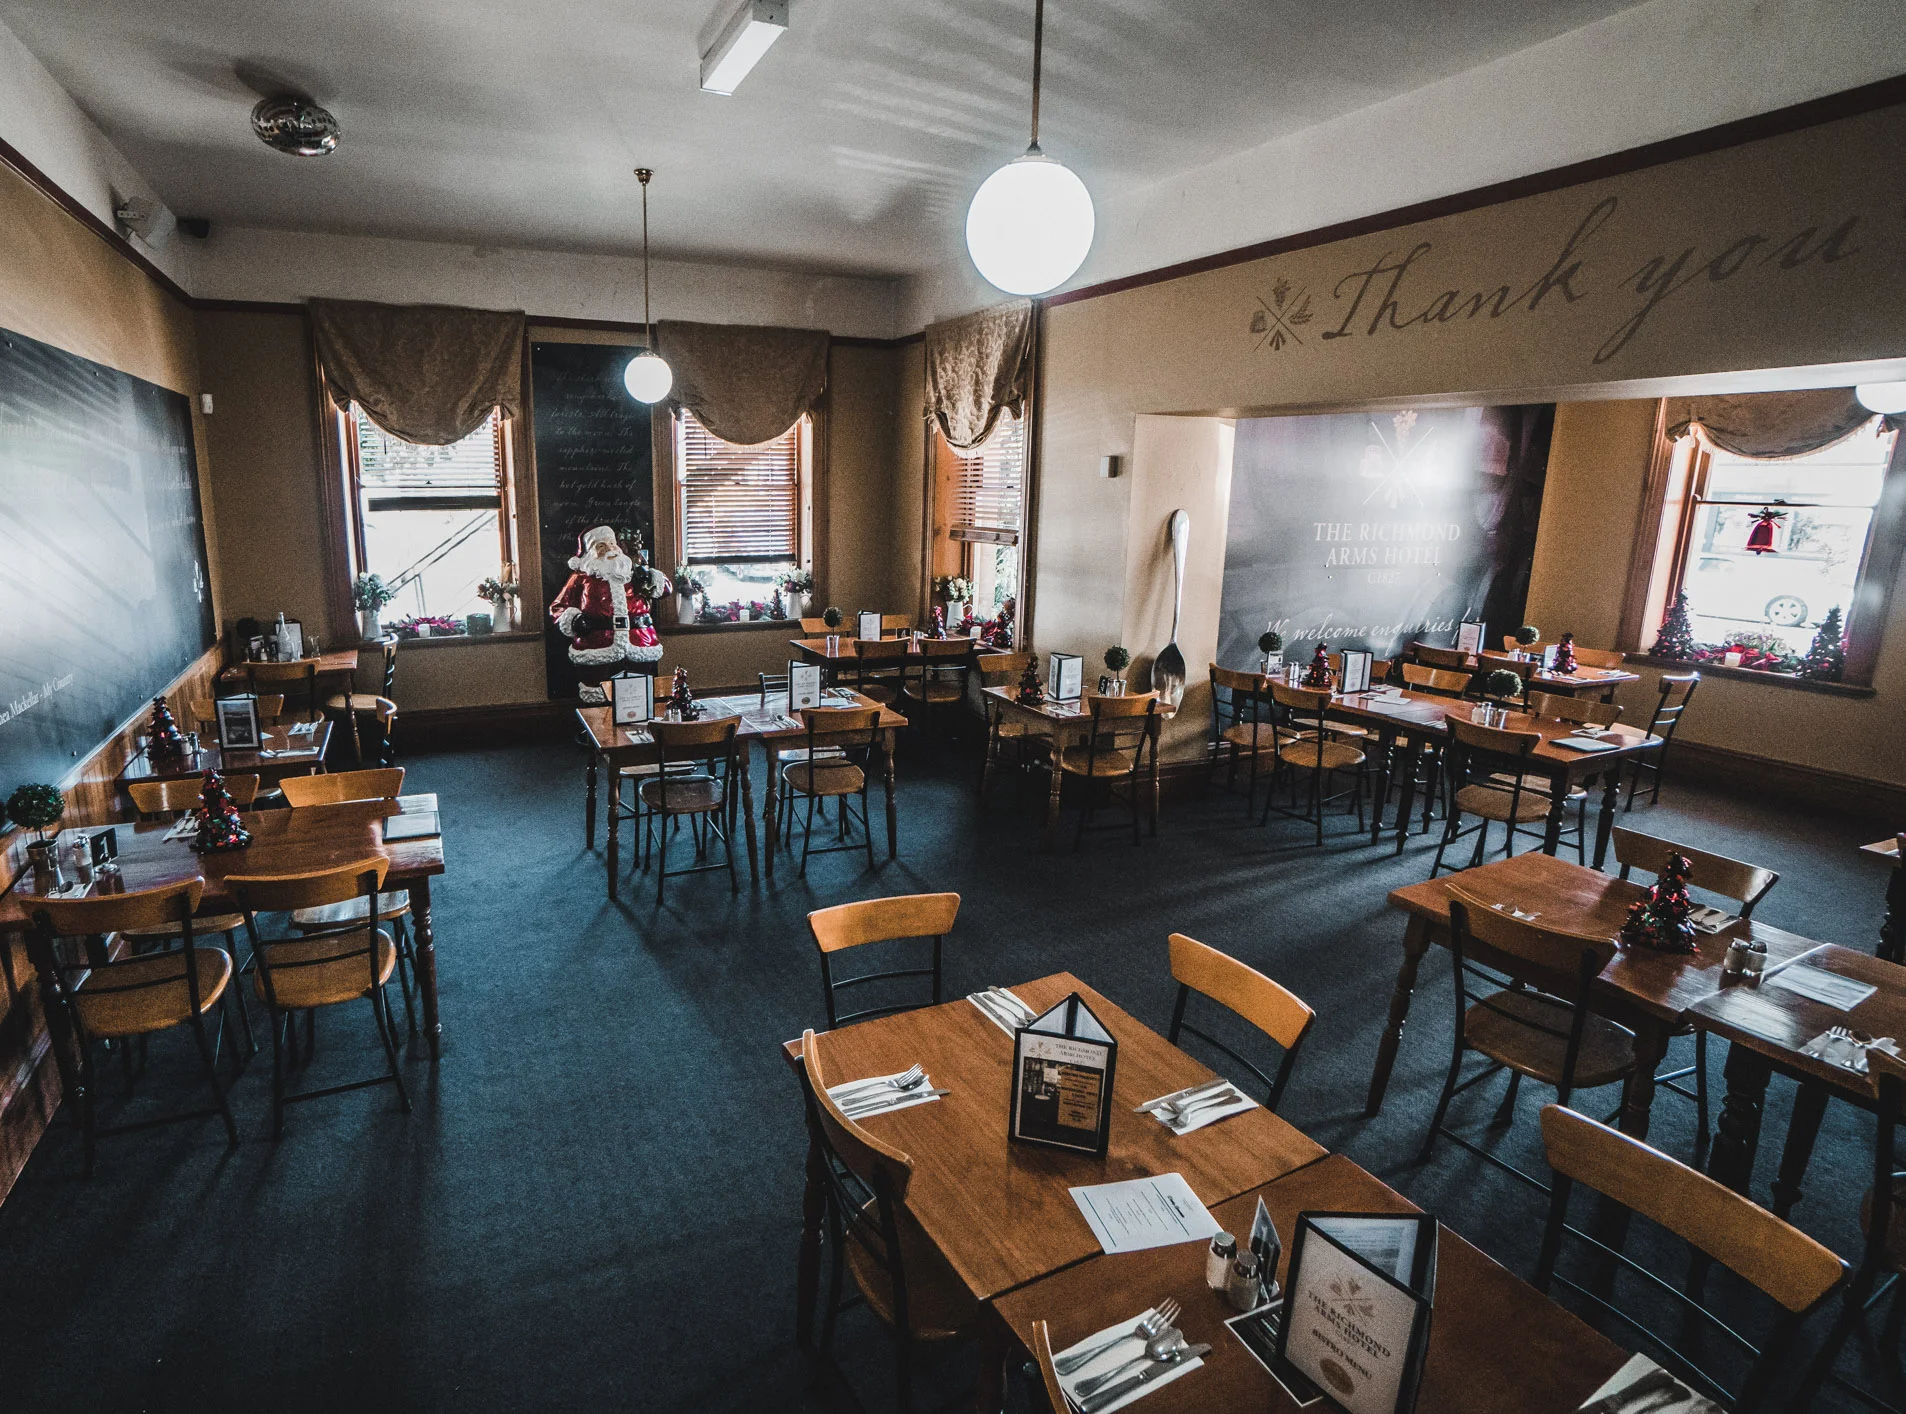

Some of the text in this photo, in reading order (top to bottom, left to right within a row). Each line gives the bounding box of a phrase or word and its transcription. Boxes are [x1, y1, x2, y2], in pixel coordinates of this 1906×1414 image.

[1321, 196, 1863, 365] Thank you
[1313, 521, 1462, 543] THE RICHMOND
[1325, 545, 1442, 567] ARMS HOTEL
[1267, 618, 1290, 638] We
[1291, 613, 1367, 641] welcome
[1370, 615, 1453, 657] enquiries
[100, 836, 109, 857] 1
[1308, 1289, 1327, 1309] THE
[1330, 1307, 1391, 1357] RICHMOND
[1315, 1305, 1341, 1329] ARMS
[1344, 1327, 1379, 1360] HOTEL
[1312, 1328, 1344, 1358] BISTRO
[1346, 1354, 1373, 1380] MENU
